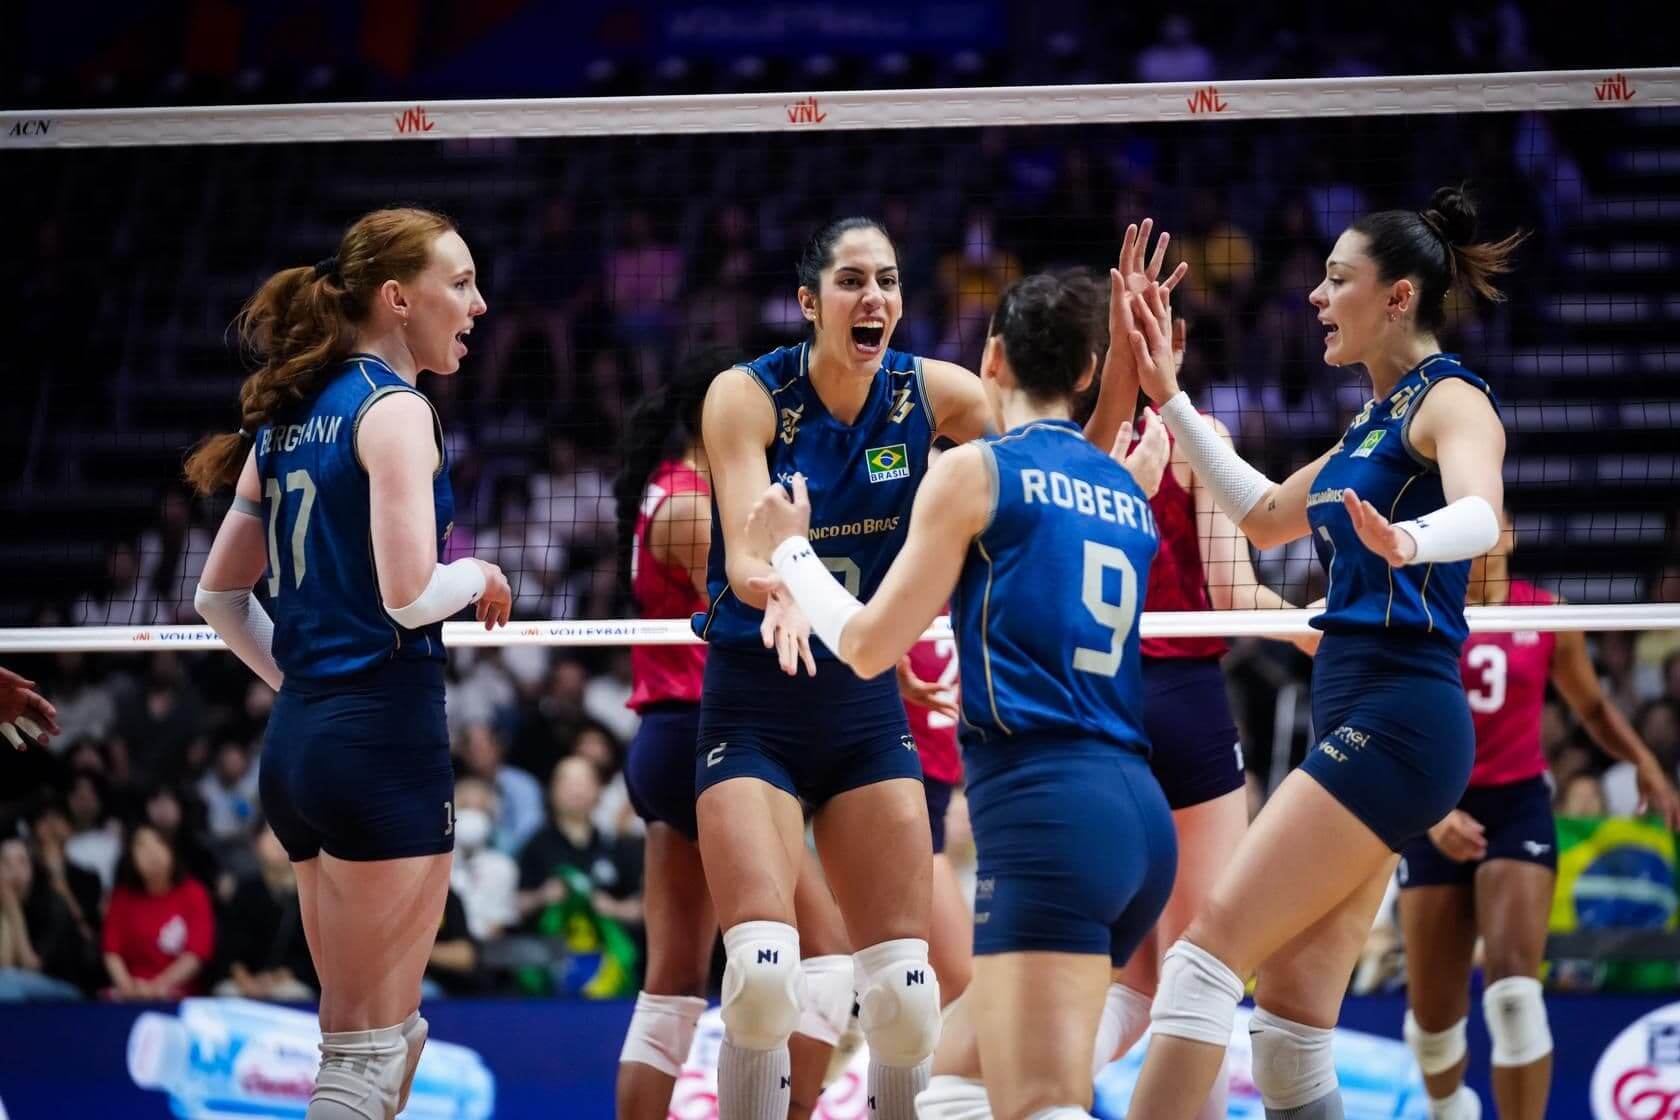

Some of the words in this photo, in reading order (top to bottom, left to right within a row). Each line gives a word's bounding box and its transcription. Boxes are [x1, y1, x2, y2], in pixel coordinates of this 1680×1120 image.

[1187, 85, 1229, 113] VNL
[1594, 72, 1637, 101] VNL
[395, 105, 435, 134] VNL
[787, 95, 828, 123] VNL
[871, 469, 909, 482] BRASIL
[265, 469, 317, 598] 17
[809, 525, 840, 542] NCO
[863, 516, 900, 534] BRAS
[1072, 539, 1138, 678] 9
